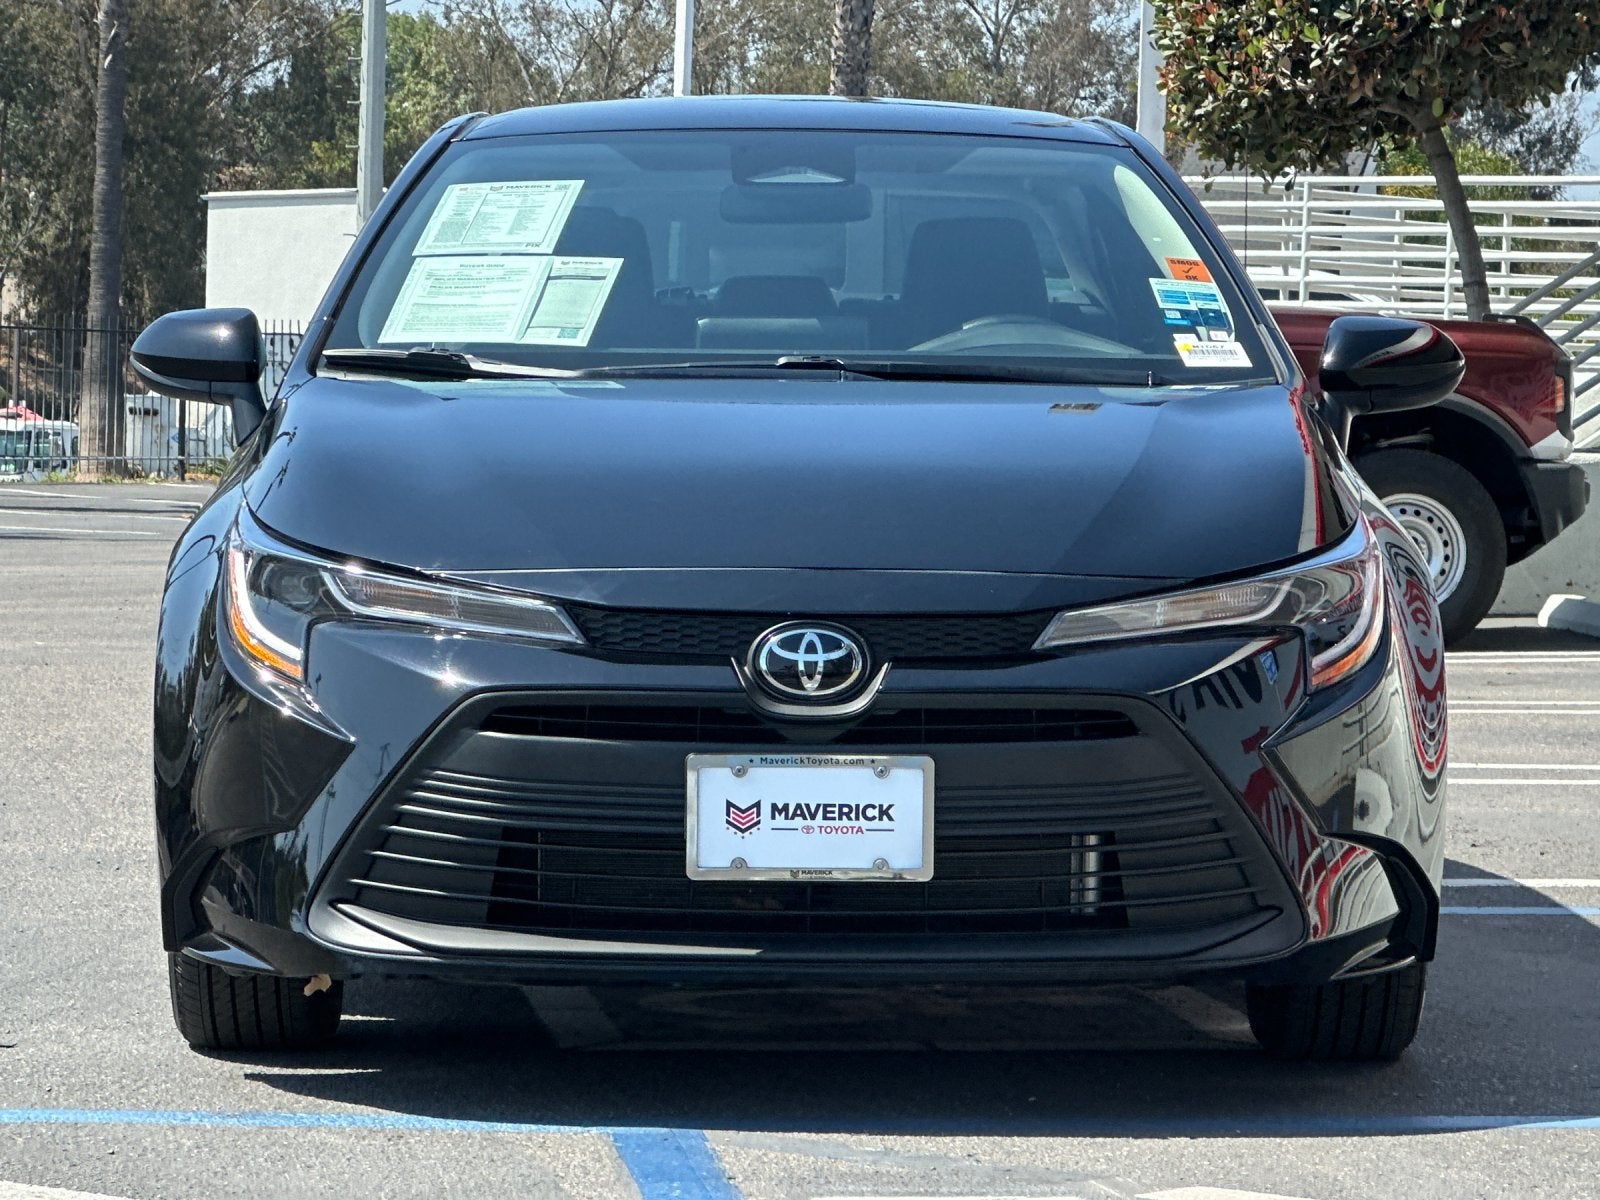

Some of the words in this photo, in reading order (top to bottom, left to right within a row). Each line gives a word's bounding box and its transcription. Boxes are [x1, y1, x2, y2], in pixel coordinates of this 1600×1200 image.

[760, 757, 865, 767] MaverickToyota.com
[770, 802, 895, 822] MAVERICK
[817, 825, 864, 835] TOYOTA
